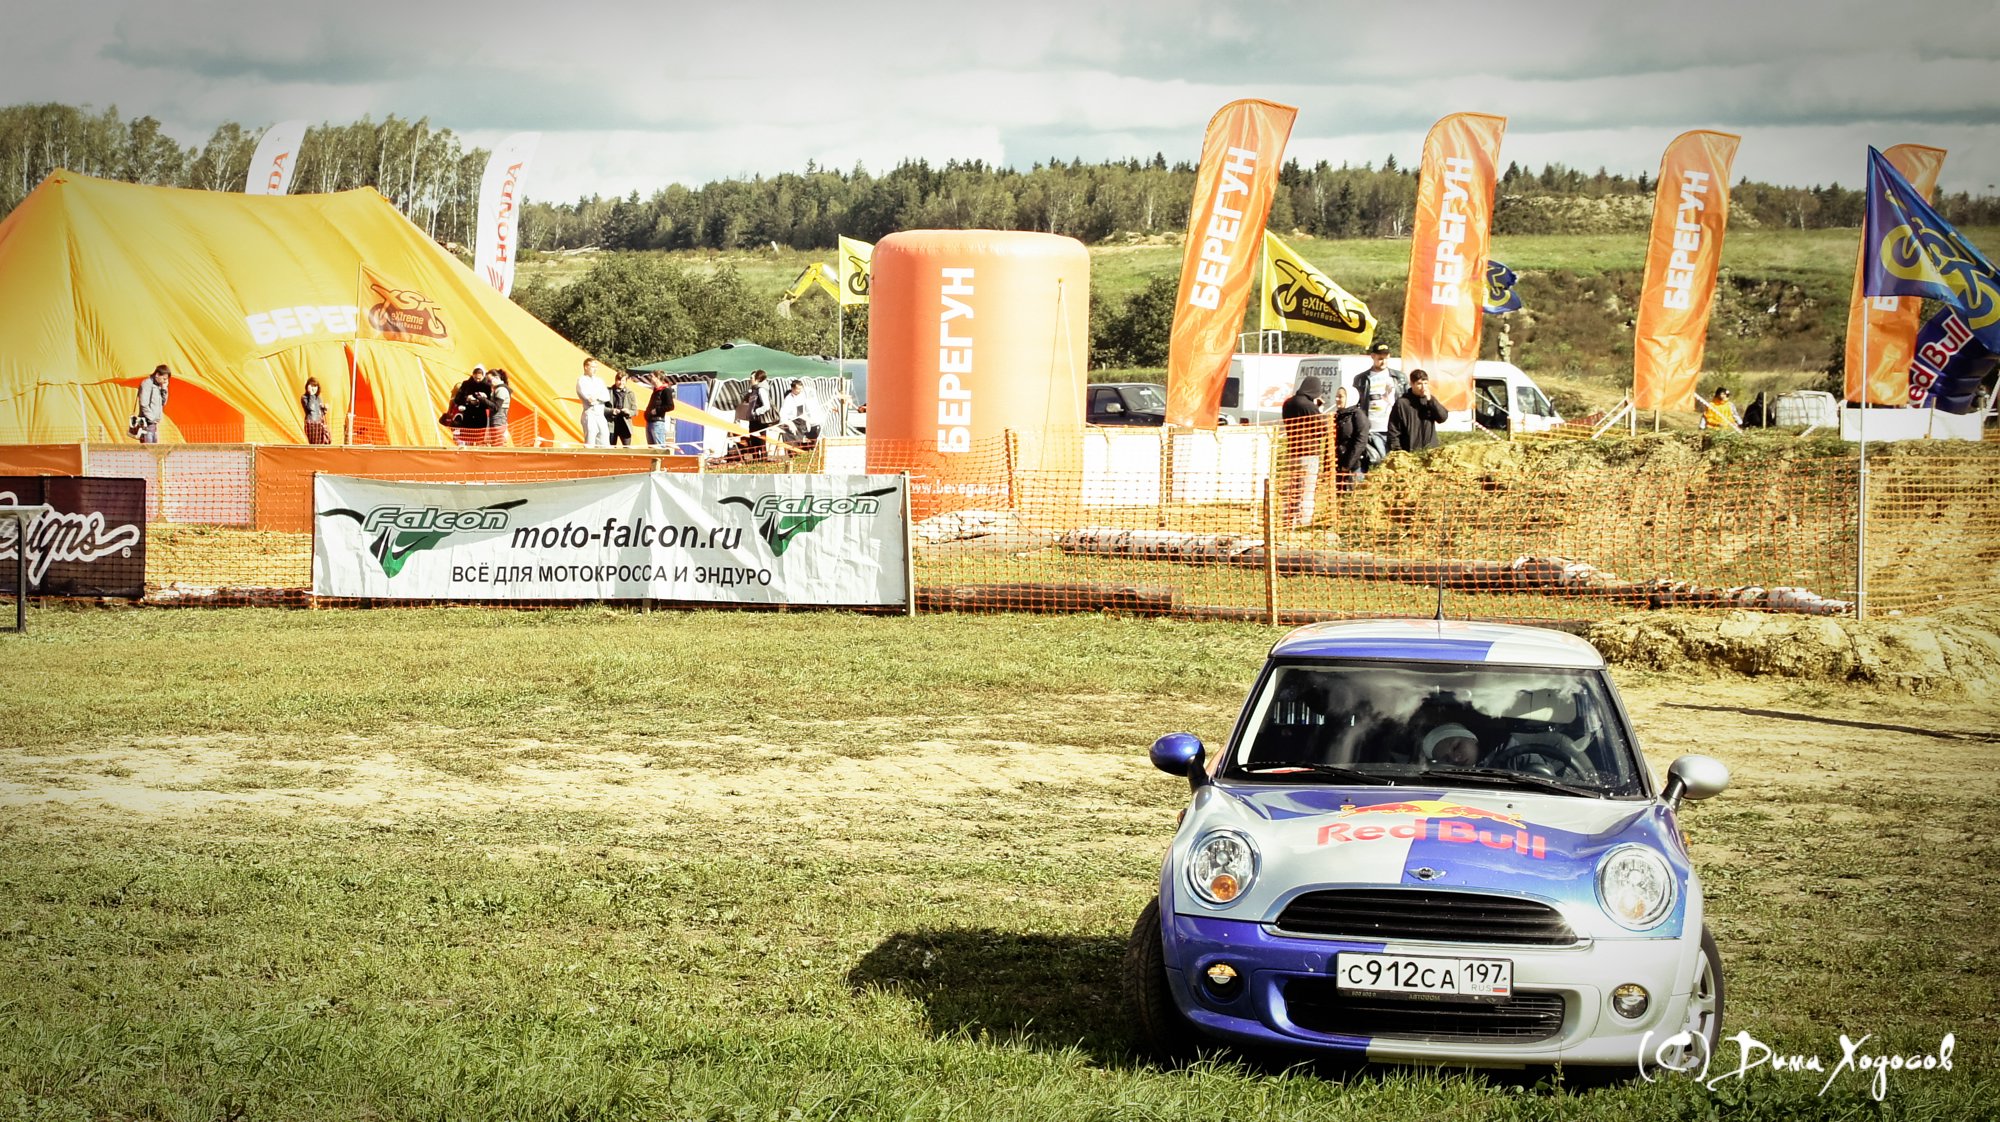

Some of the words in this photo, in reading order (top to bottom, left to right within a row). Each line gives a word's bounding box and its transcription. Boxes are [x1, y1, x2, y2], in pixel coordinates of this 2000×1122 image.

[495, 162, 524, 263] HONDA
[1189, 146, 1258, 310] БЕРЕГУН
[1432, 157, 1475, 307] БЕРЕГУН
[1662, 170, 1710, 311] БЕРЕГУН
[245, 304, 358, 345] БЕРЕГ
[1302, 297, 1338, 317] eXtre
[938, 267, 974, 453] БЕРЕГУН
[1918, 314, 1974, 372] Bull
[1299, 366, 1339, 377] MOTOCROSS
[1909, 359, 1939, 409] ed
[362, 504, 514, 534] Falcon
[752, 491, 883, 518] Falcon
[511, 516, 742, 551] moto-falcon.ru
[452, 562, 490, 584] ВСЁ
[493, 565, 534, 587] ДЛЯ
[538, 563, 669, 585] МОТОКРОССА
[674, 566, 689, 583] И
[694, 565, 772, 588] ЭНДУРО
[1317, 818, 1428, 846] Red
[1438, 820, 1547, 860] Bull
[1463, 962, 1504, 984] 197
[1471, 983, 1492, 993] RUS
